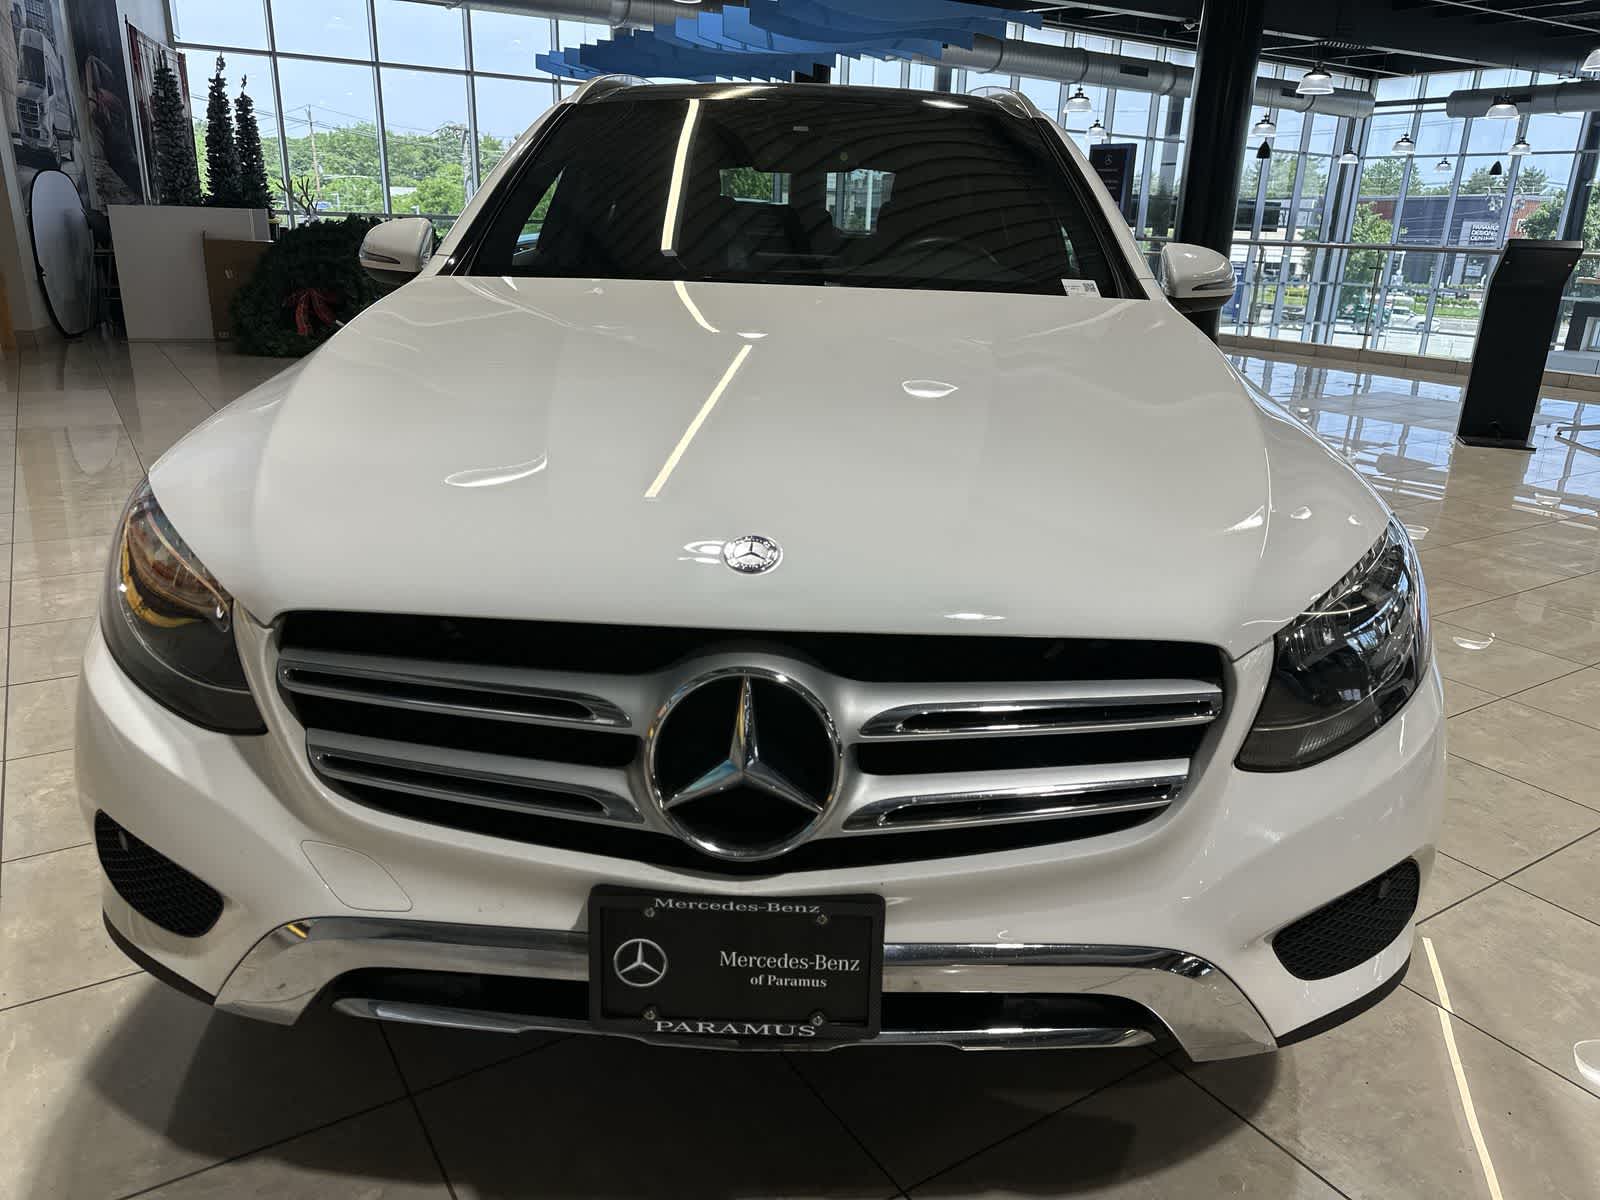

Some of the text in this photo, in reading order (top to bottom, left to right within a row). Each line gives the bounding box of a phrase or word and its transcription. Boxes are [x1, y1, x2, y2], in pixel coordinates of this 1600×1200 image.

[654, 898, 820, 913] Mercedes-Benz
[719, 950, 861, 972] Mercedes-Benz
[749, 974, 828, 988] of Paramus
[655, 1021, 816, 1037] PARAMUS
